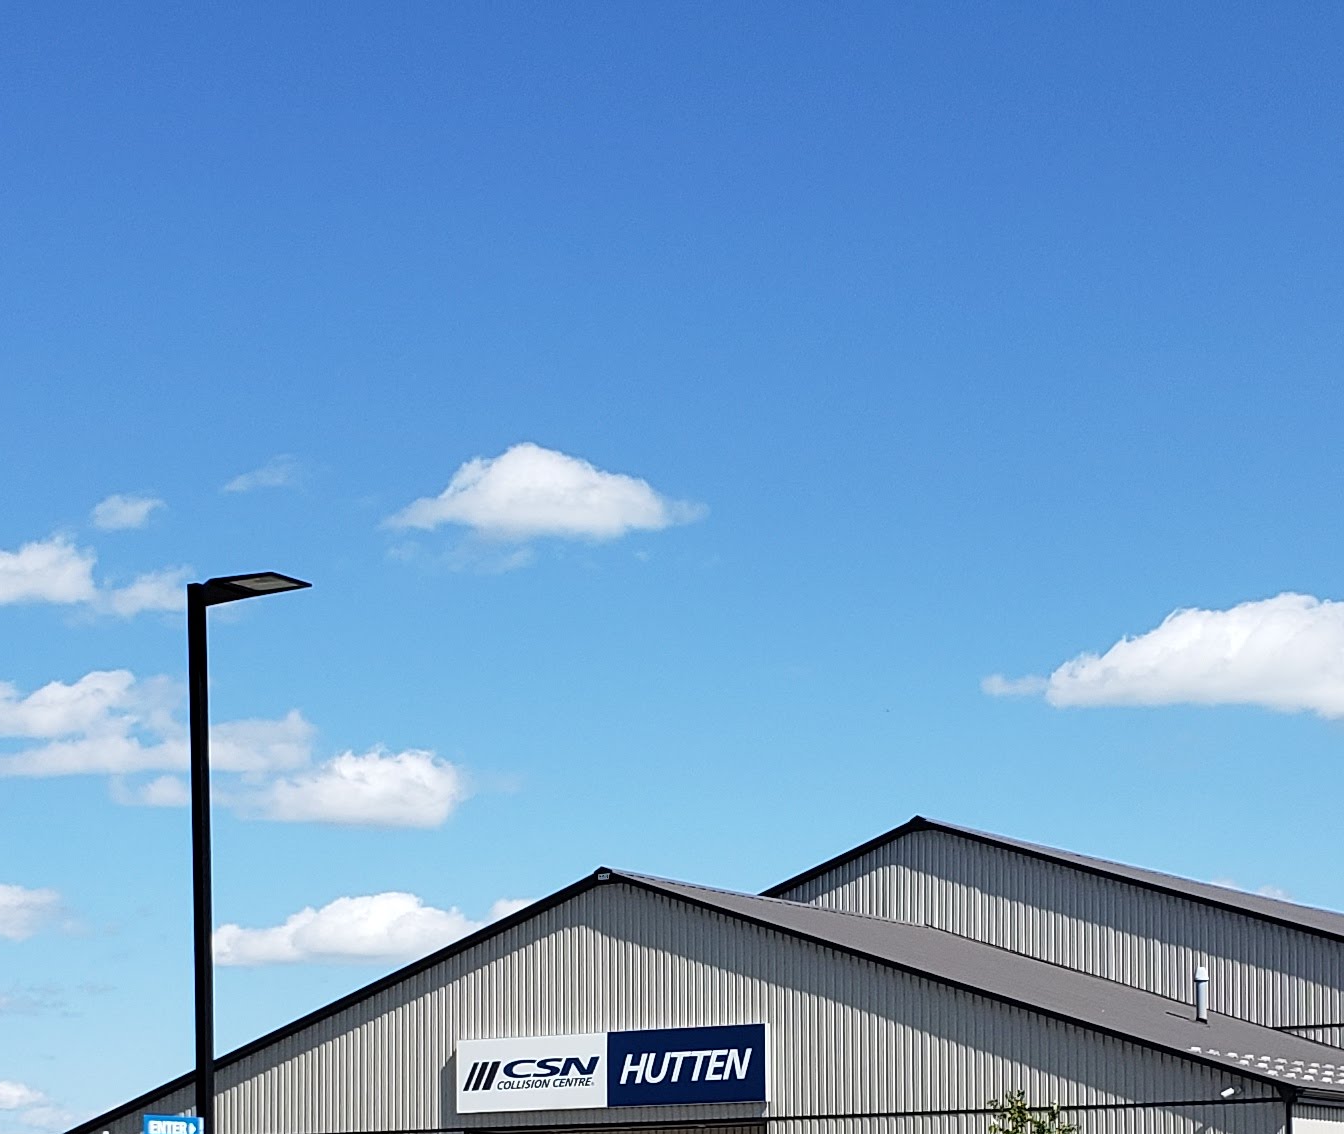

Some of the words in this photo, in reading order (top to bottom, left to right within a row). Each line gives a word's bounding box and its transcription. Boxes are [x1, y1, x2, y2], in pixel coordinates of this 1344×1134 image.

[503, 1056, 600, 1078] CSN
[619, 1048, 752, 1085] HUTTEN
[497, 1079, 551, 1090] COLLISION
[553, 1077, 592, 1087] CENTRE
[148, 1120, 187, 1134] ENTER
